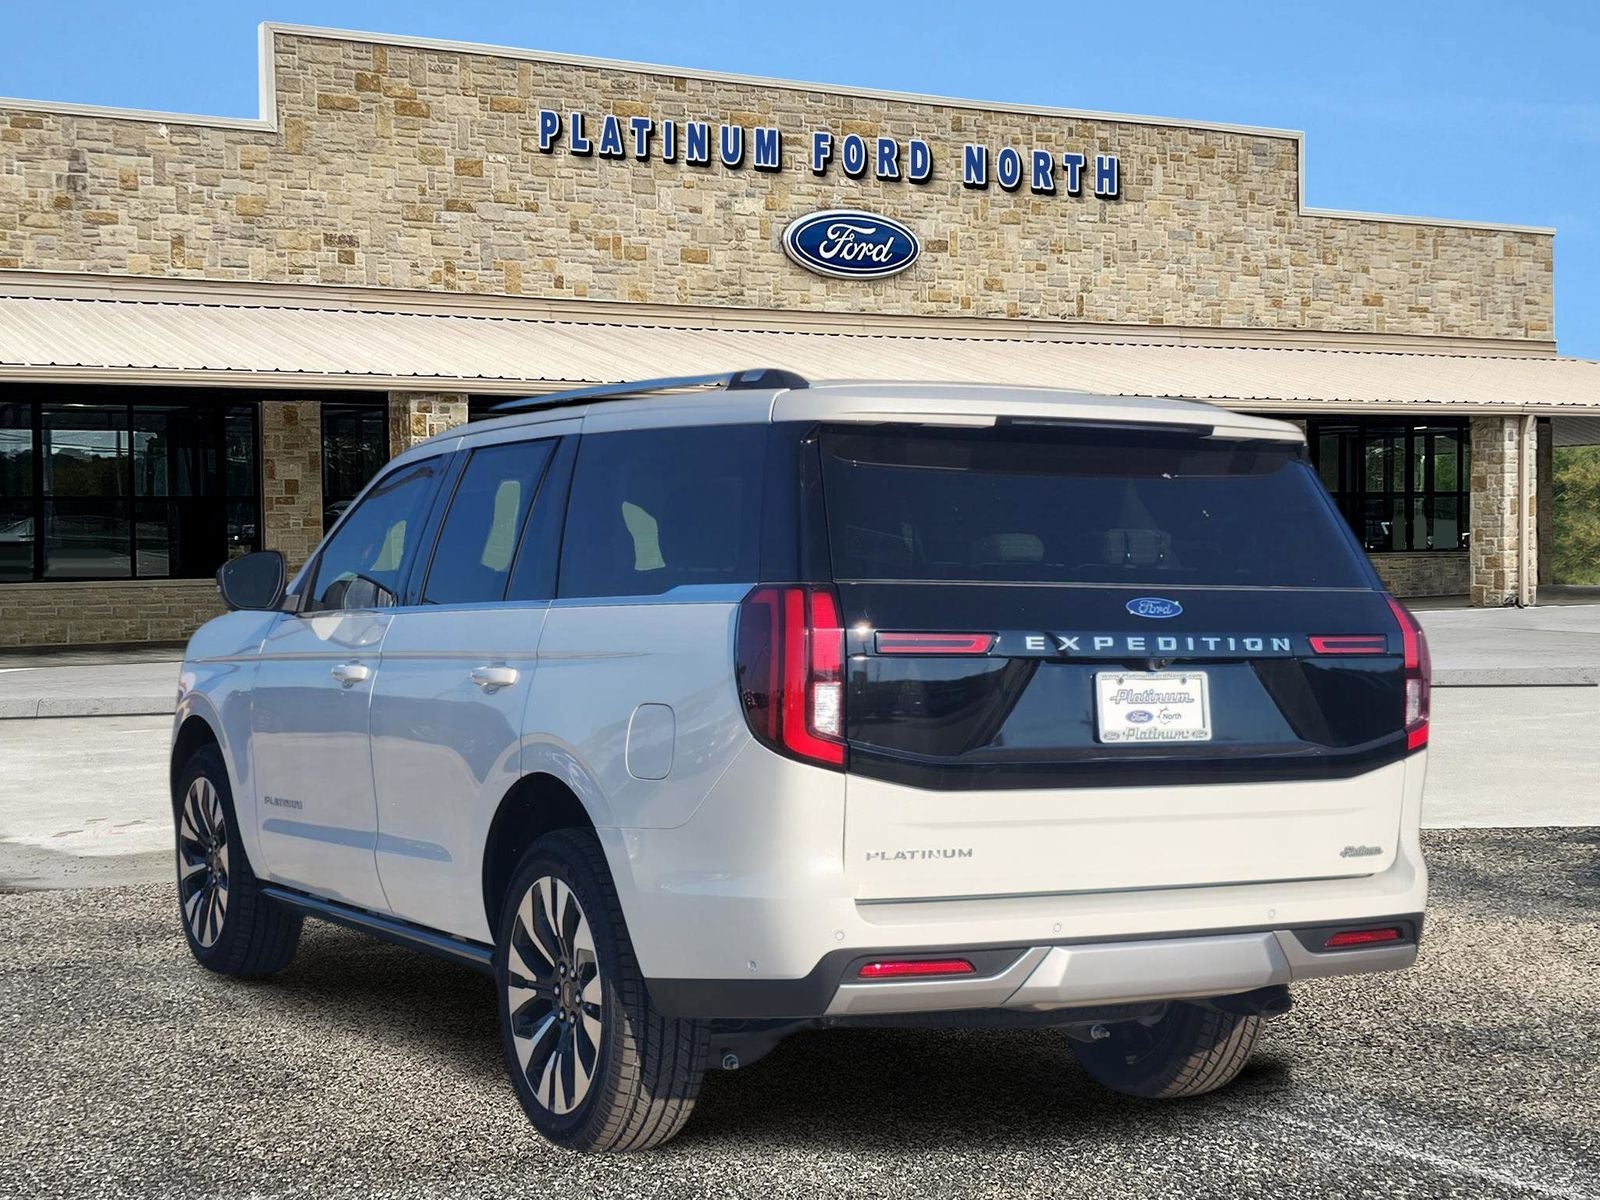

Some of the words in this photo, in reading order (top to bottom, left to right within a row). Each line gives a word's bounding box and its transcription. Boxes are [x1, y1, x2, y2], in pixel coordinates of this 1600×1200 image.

[538, 109, 782, 172] PLATINUM
[812, 131, 934, 184] FORD
[963, 144, 1121, 199] NORTH
[819, 223, 895, 263] Ford
[1138, 600, 1173, 615] Ford
[1025, 636, 1290, 651] EXPEDITION
[1109, 689, 1195, 705] Platinum
[1162, 712, 1182, 720] North
[1125, 727, 1189, 740] Platinum
[866, 848, 973, 861] PLATINUM
